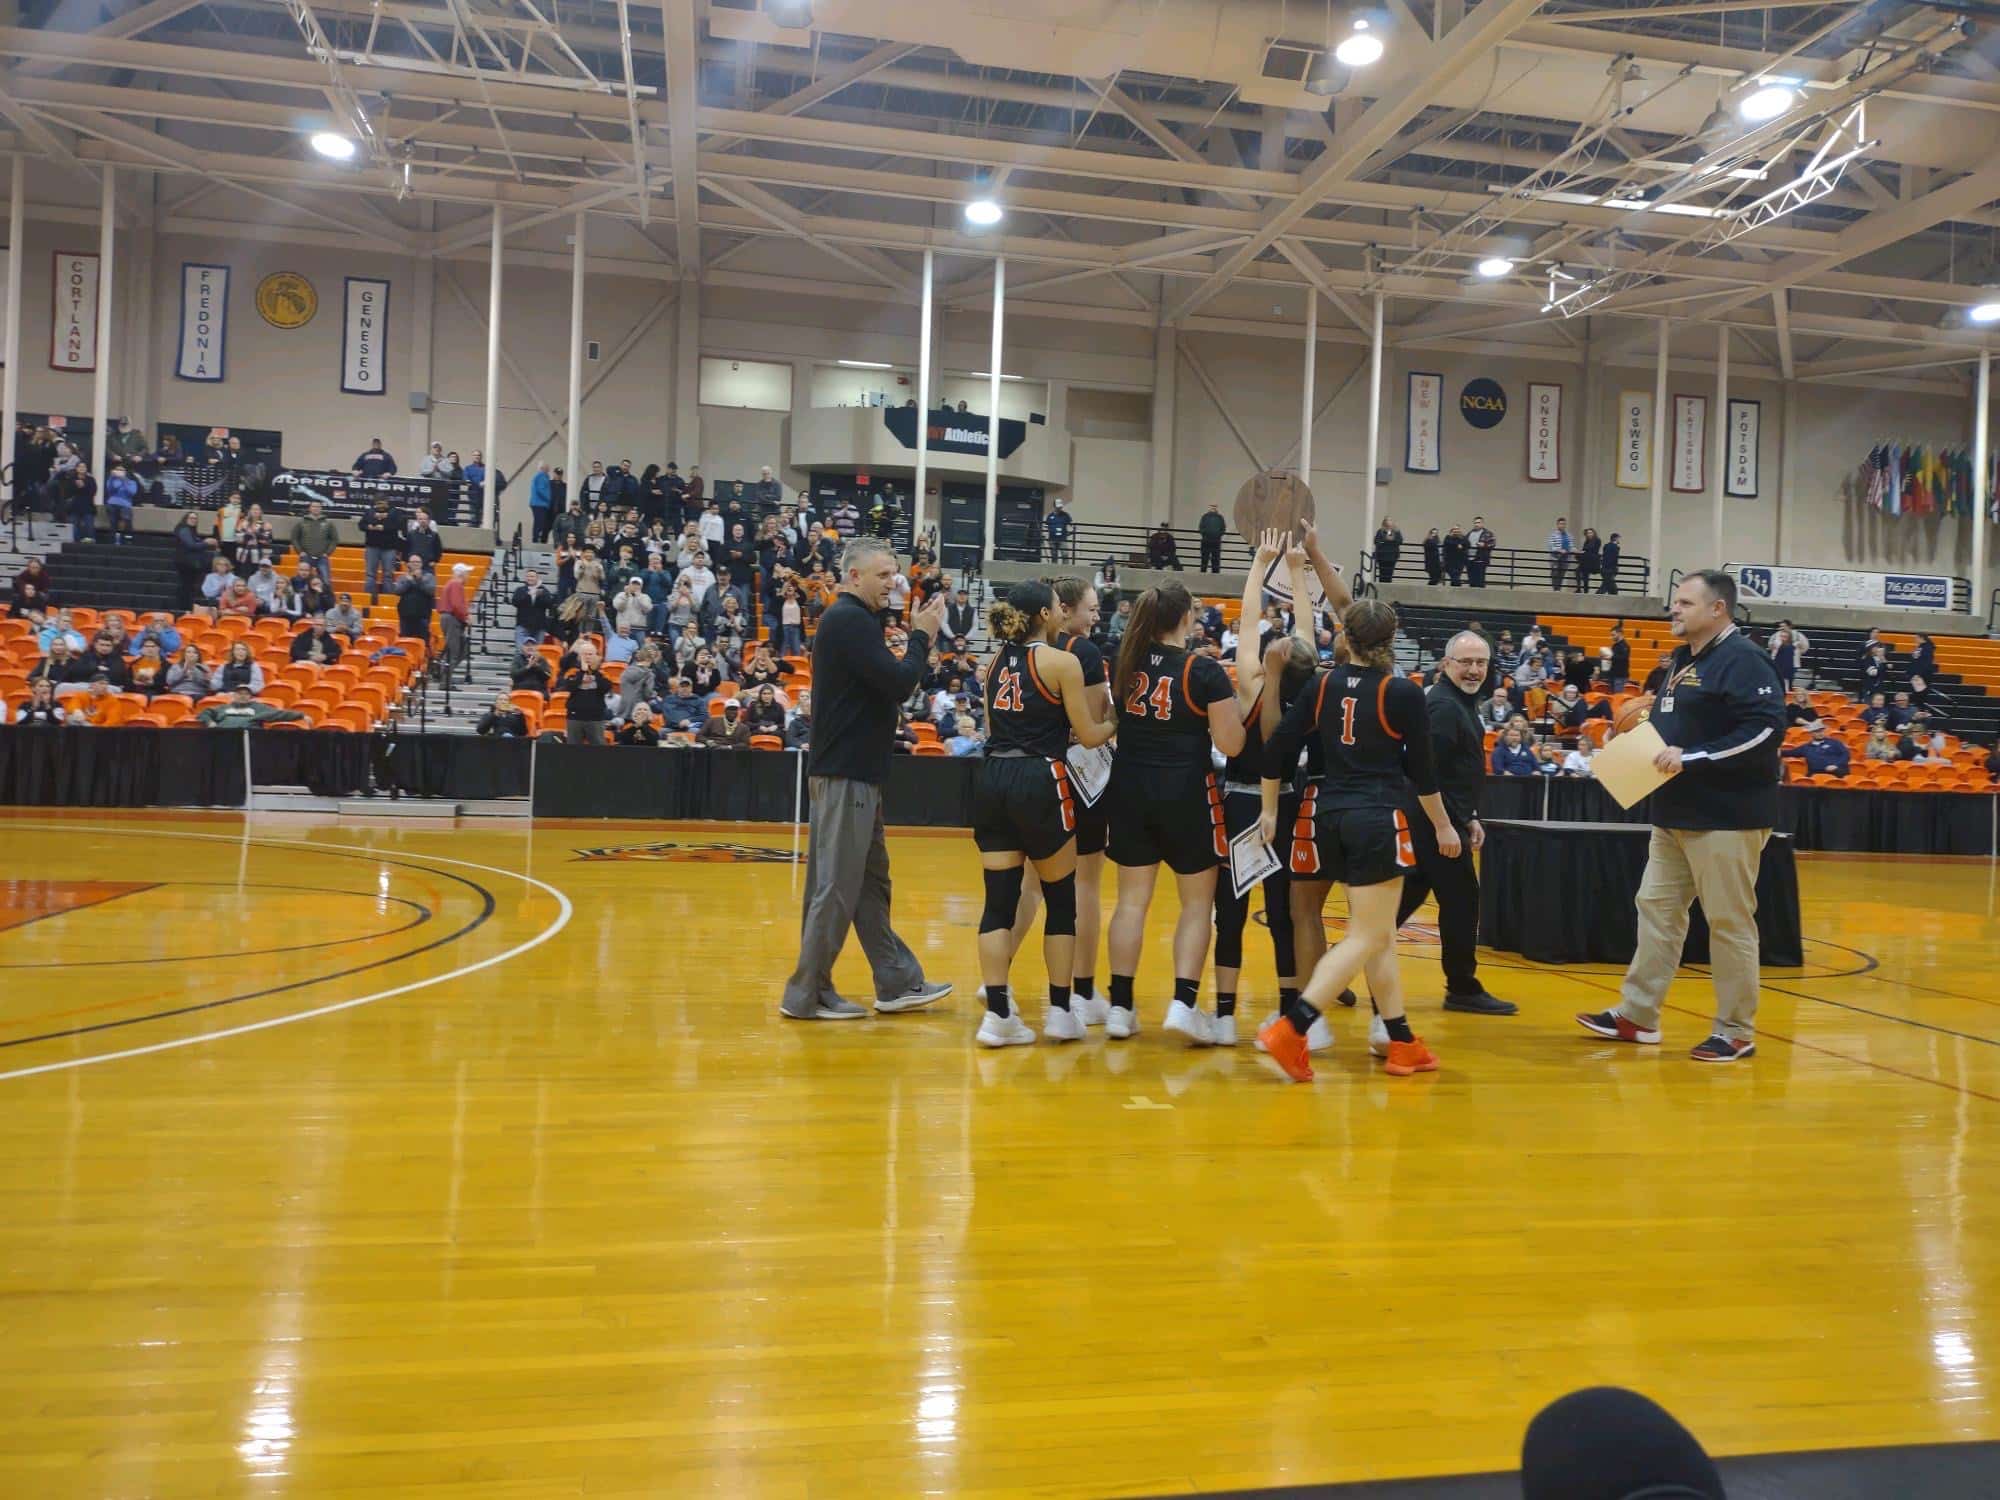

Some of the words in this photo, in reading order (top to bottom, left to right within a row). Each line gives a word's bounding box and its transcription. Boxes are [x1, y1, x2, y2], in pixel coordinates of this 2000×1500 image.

[67, 261, 84, 362] CORTLAND
[196, 271, 211, 375] FREDONIA
[358, 291, 373, 382] GENESEO
[1462, 395, 1504, 411] NCAA
[1536, 394, 1550, 471] ONEONTA
[1629, 406, 1641, 472] OSWEGO
[1736, 411, 1748, 486] POTSDAM
[350, 481, 433, 494] SPORTS
[1776, 571, 1831, 586] BUFFALO
[1150, 654, 1164, 667] W
[1346, 676, 1362, 689] W
[992, 667, 1024, 712] 21
[1126, 671, 1174, 721] 24
[1340, 696, 1358, 746] 1
